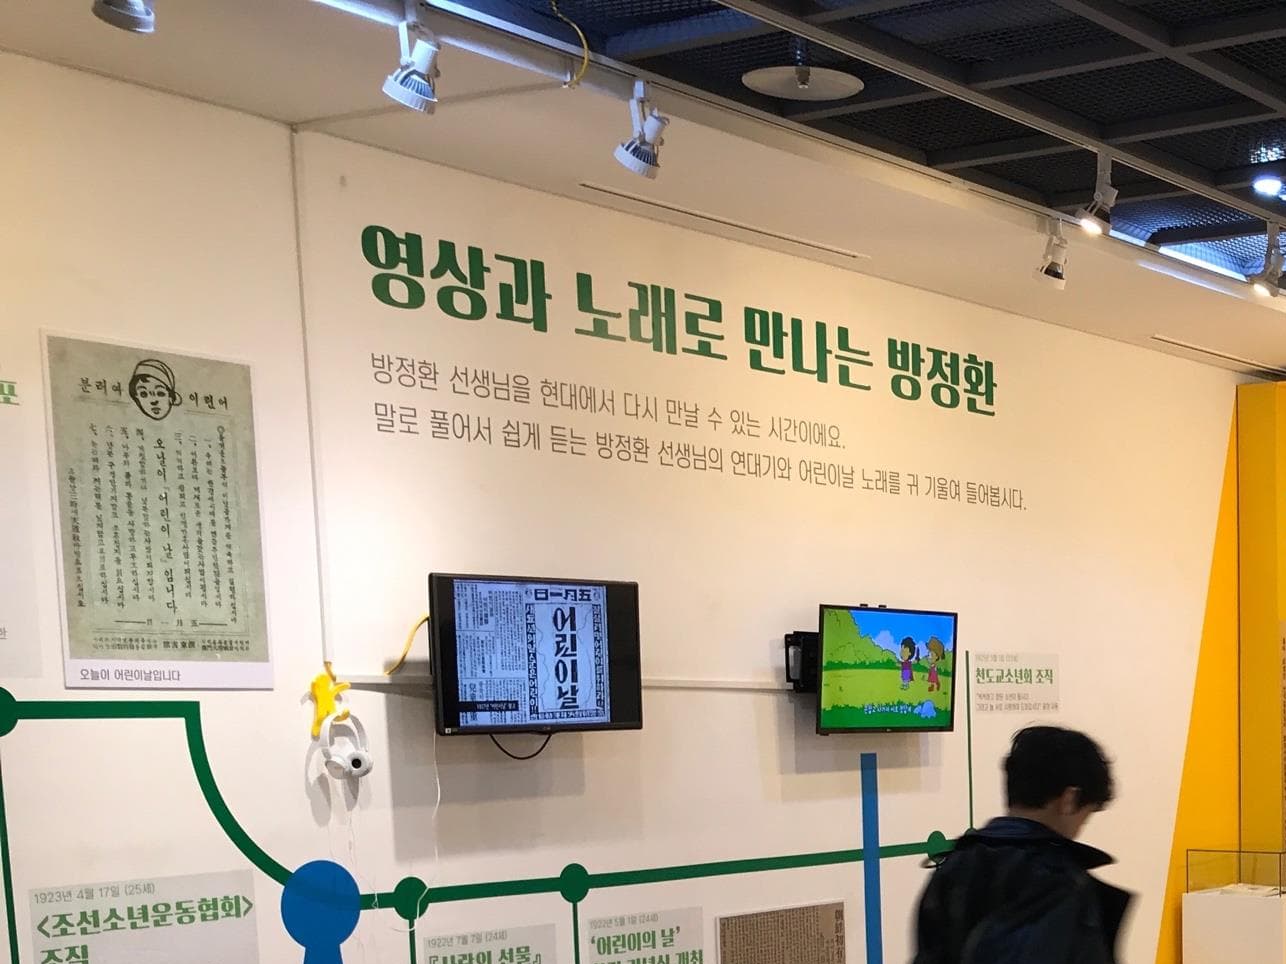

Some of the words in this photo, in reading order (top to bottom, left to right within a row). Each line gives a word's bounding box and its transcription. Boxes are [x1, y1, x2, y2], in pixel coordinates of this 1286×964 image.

[361, 224, 552, 332] 영상과
[574, 272, 728, 361] 노래로
[743, 305, 873, 391] 만나는
[887, 336, 997, 417] 방정환
[371, 353, 440, 392] 방정환
[449, 363, 532, 404] 선생님을
[540, 377, 616, 417] 현대에서
[623, 391, 659, 424] 다시
[666, 398, 700, 429] 만날
[706, 408, 723, 432] 수
[730, 408, 761, 438] 있는
[769, 415, 847, 451] 시간이에요.
[373, 402, 418, 436] 말로
[430, 408, 492, 445] 풀어서
[502, 419, 541, 451] 쉽게
[549, 425, 588, 456] 듣는
[596, 431, 650, 465] 방정환
[657, 439, 724, 475] 선생님의
[729, 450, 791, 483] 연대기와
[798, 458, 855, 489] 어린이날
[861, 466, 901, 496] 노래를
[907, 472, 920, 497] 귀
[923, 474, 961, 503] 기울여
[965, 479, 1028, 513] 들어봅시다.
[80, 667, 110, 681] 오늘이
[113, 668, 181, 682] 어린이날입니다
[552, 606, 579, 709] 어린이날
[975, 667, 1033, 685] 천도교소년회
[1036, 668, 1054, 684] 조직
[34, 889, 73, 904] 1923년
[77, 888, 94, 901] 4월
[100, 886, 120, 899] 17일
[124, 883, 156, 897] (25세)
[37, 894, 254, 939] <조선소년운동협회>
